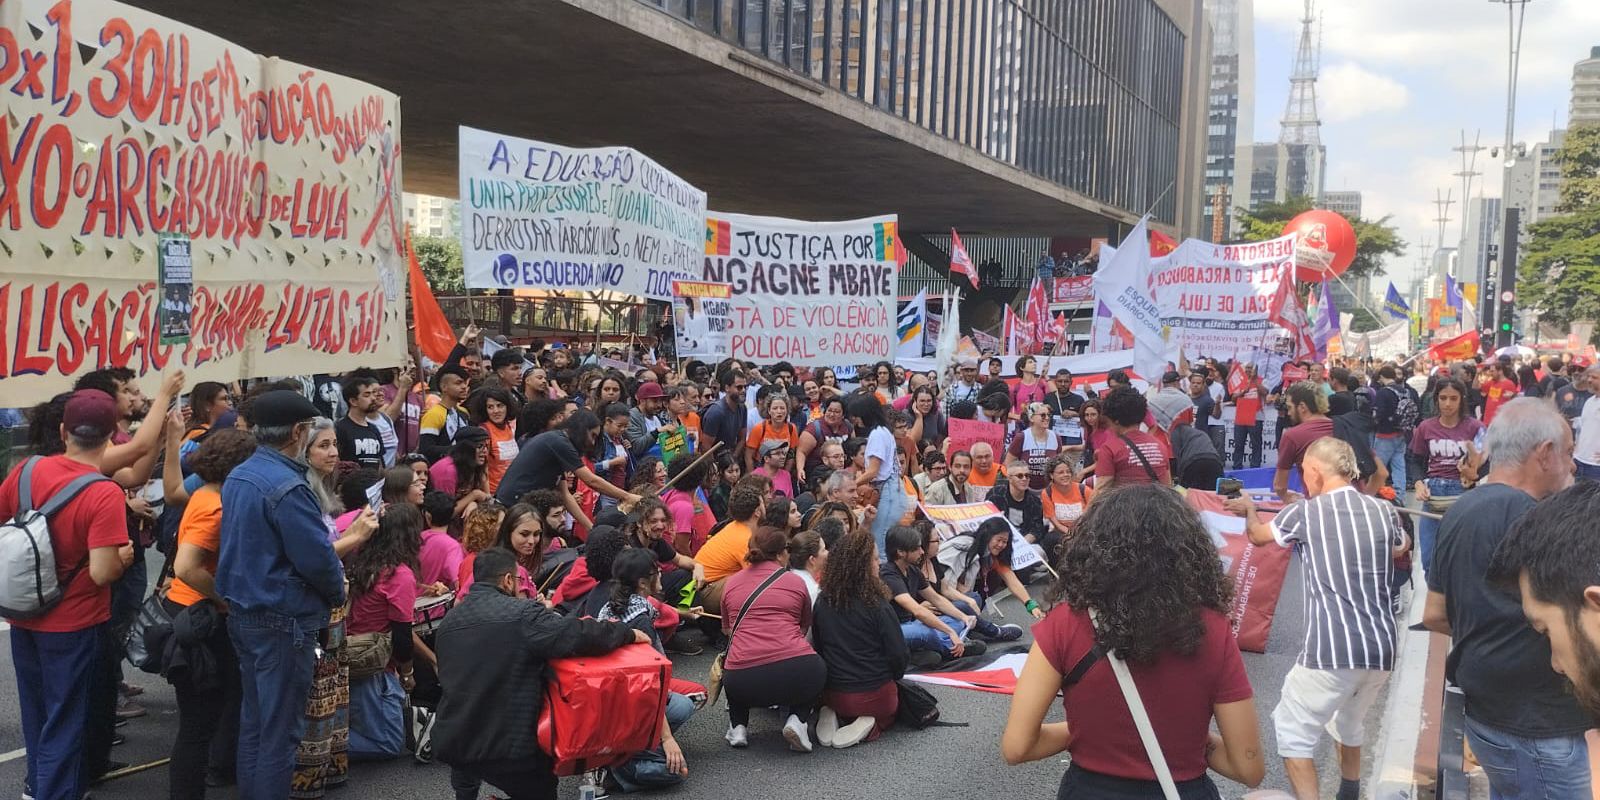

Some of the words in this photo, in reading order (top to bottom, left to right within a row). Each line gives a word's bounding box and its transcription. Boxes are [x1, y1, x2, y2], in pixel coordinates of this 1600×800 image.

[187, 48, 243, 142] SEM
[488, 139, 510, 174] A
[81, 133, 267, 249] ARCABOUÇO
[270, 194, 292, 221] DE
[290, 178, 349, 242] LULA
[470, 177, 515, 211] UNIR
[472, 212, 556, 252] DERROTAR
[633, 232, 661, 264] NEM
[736, 231, 839, 266] JUSTIÇA
[843, 235, 873, 260] POR
[523, 260, 594, 287] ESQUERDA
[829, 264, 892, 297] MBAYE
[264, 283, 349, 353] LUTAS
[773, 306, 796, 329] DE
[802, 300, 888, 329] VIOLÊNCIA
[732, 335, 816, 359] POLICIAL
[833, 331, 889, 357] RACISMO
